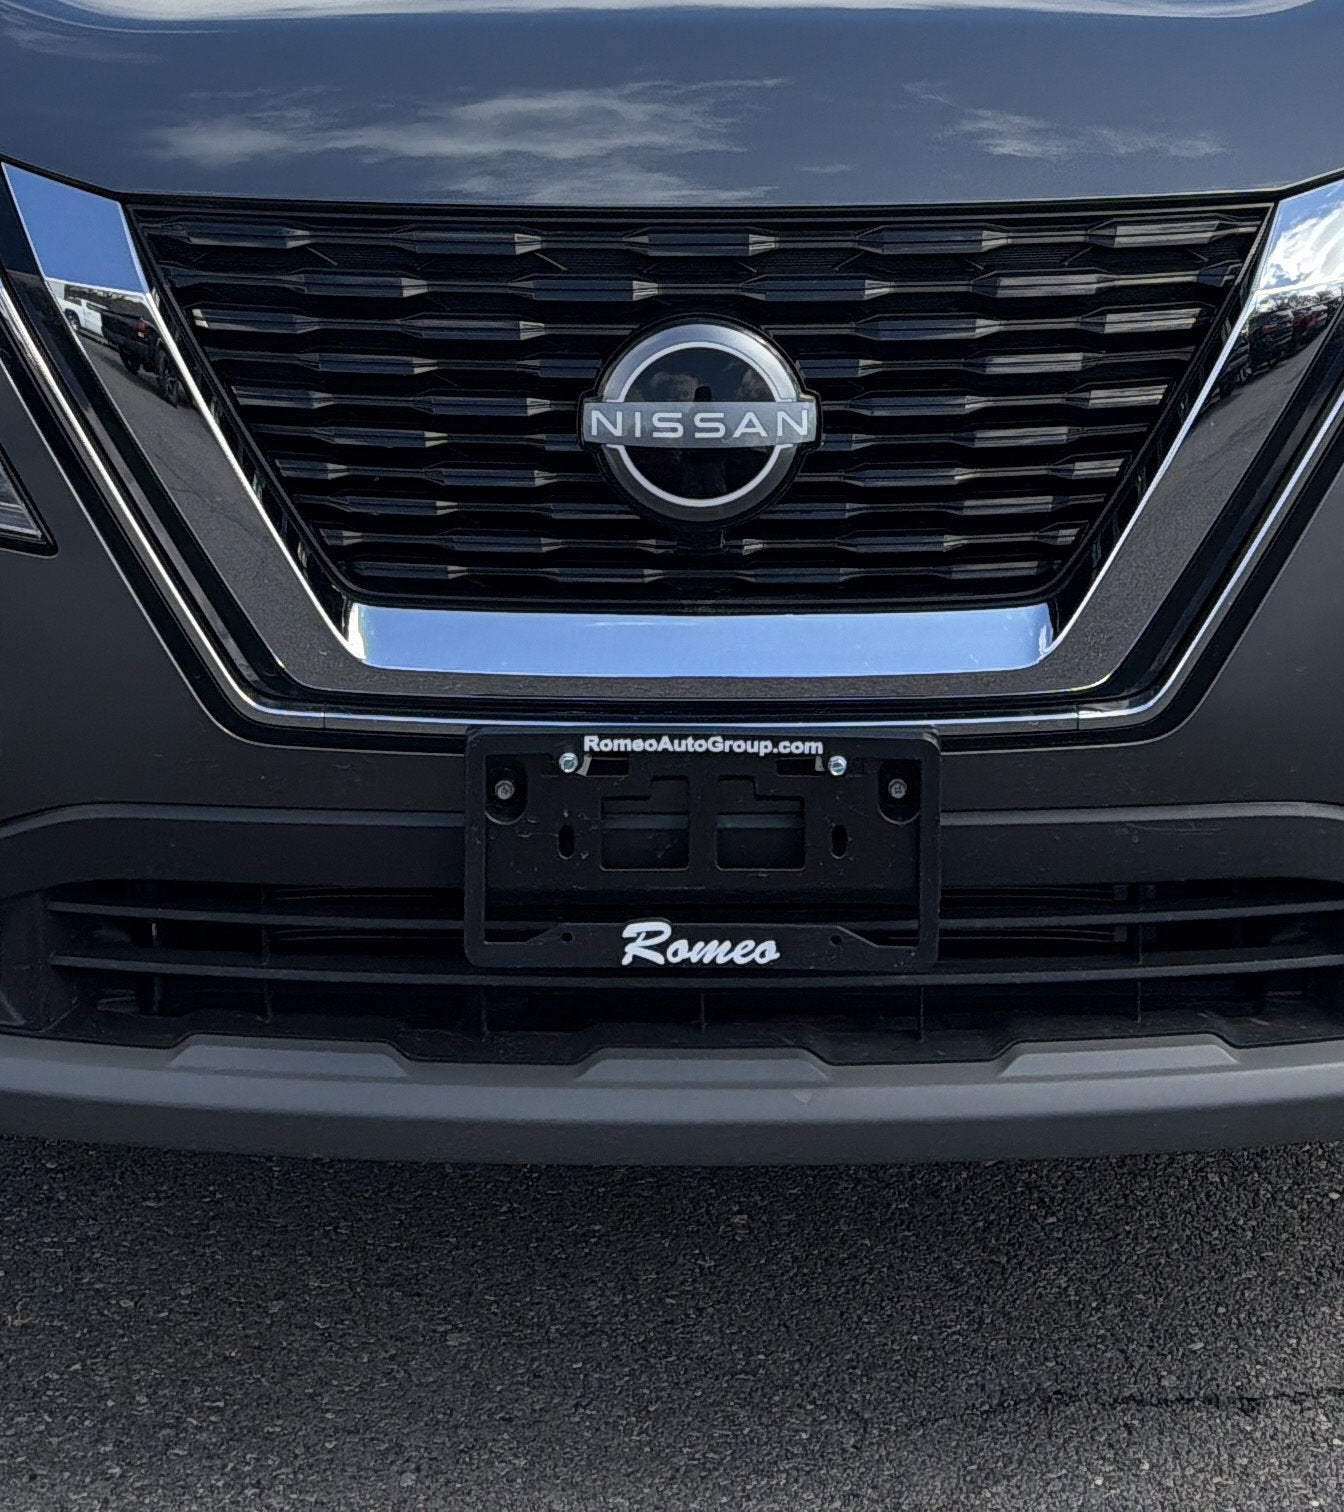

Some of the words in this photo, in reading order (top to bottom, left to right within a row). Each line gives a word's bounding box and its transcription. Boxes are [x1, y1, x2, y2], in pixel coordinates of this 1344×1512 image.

[591, 409, 808, 438] NISSAN
[583, 735, 824, 757] RomeoAutoGroup.com
[621, 921, 781, 966] Romeo
